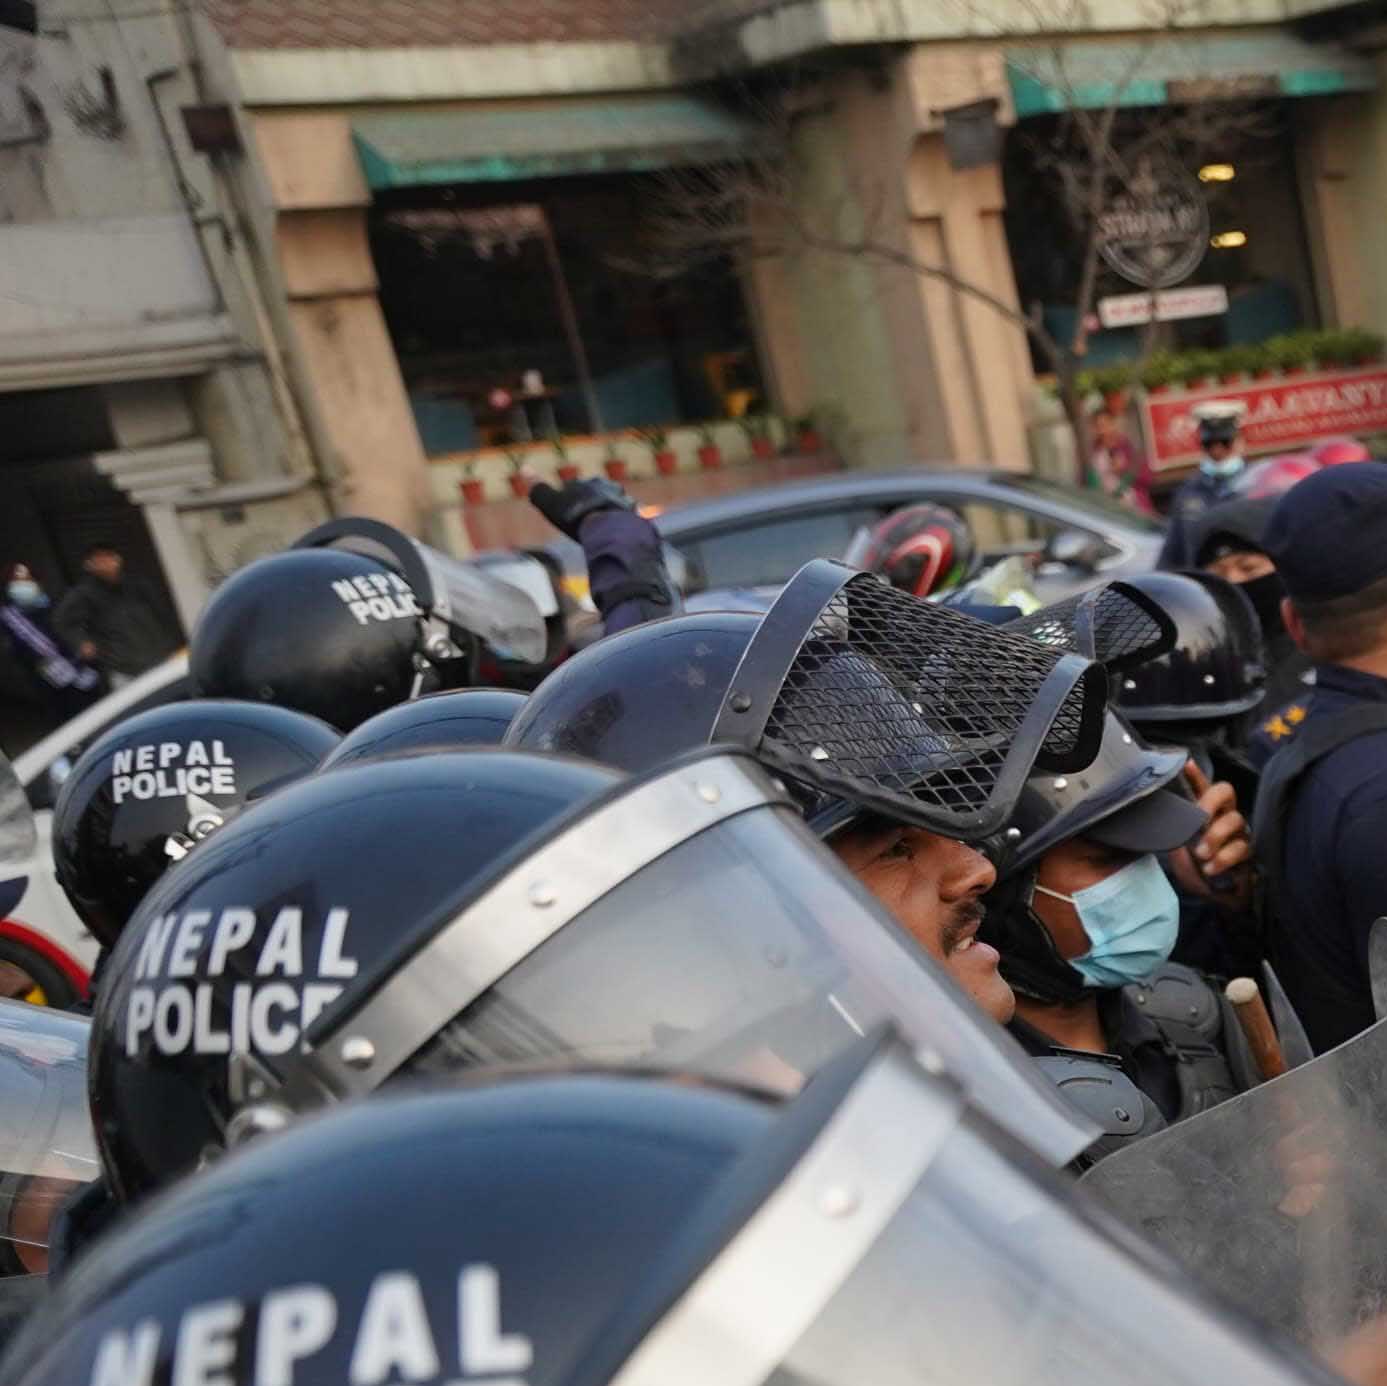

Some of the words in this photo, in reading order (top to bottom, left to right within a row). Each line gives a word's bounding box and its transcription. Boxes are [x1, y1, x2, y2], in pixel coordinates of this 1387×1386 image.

[112, 739, 234, 776] NEPAL
[112, 766, 237, 804] POLICE
[134, 904, 359, 981] NEPAL
